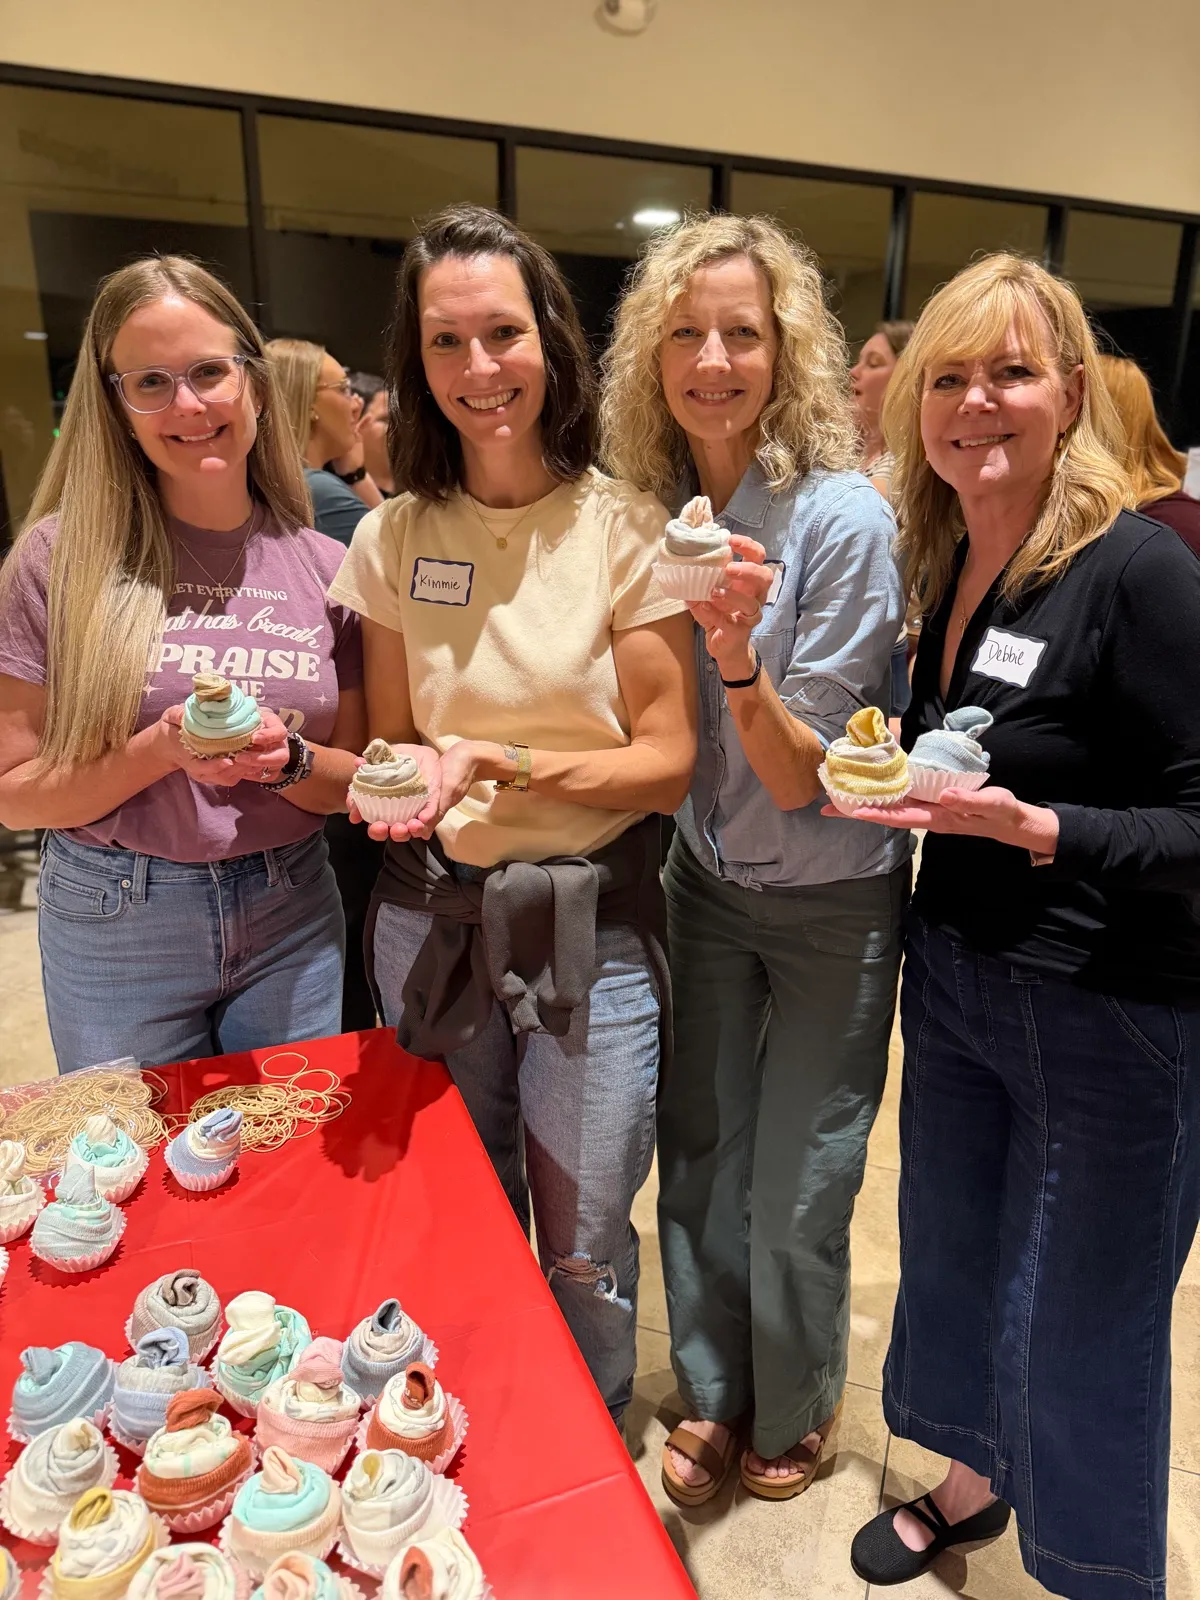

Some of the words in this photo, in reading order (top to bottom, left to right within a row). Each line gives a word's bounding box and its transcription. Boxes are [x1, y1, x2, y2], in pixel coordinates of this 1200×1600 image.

[195, 584, 288, 601] EVERYTHING
[420, 573, 461, 590] Kimmie
[192, 599, 244, 630] has
[246, 605, 324, 649] breath
[148, 643, 321, 682] PRAISE
[982, 639, 1025, 666] Debbie
